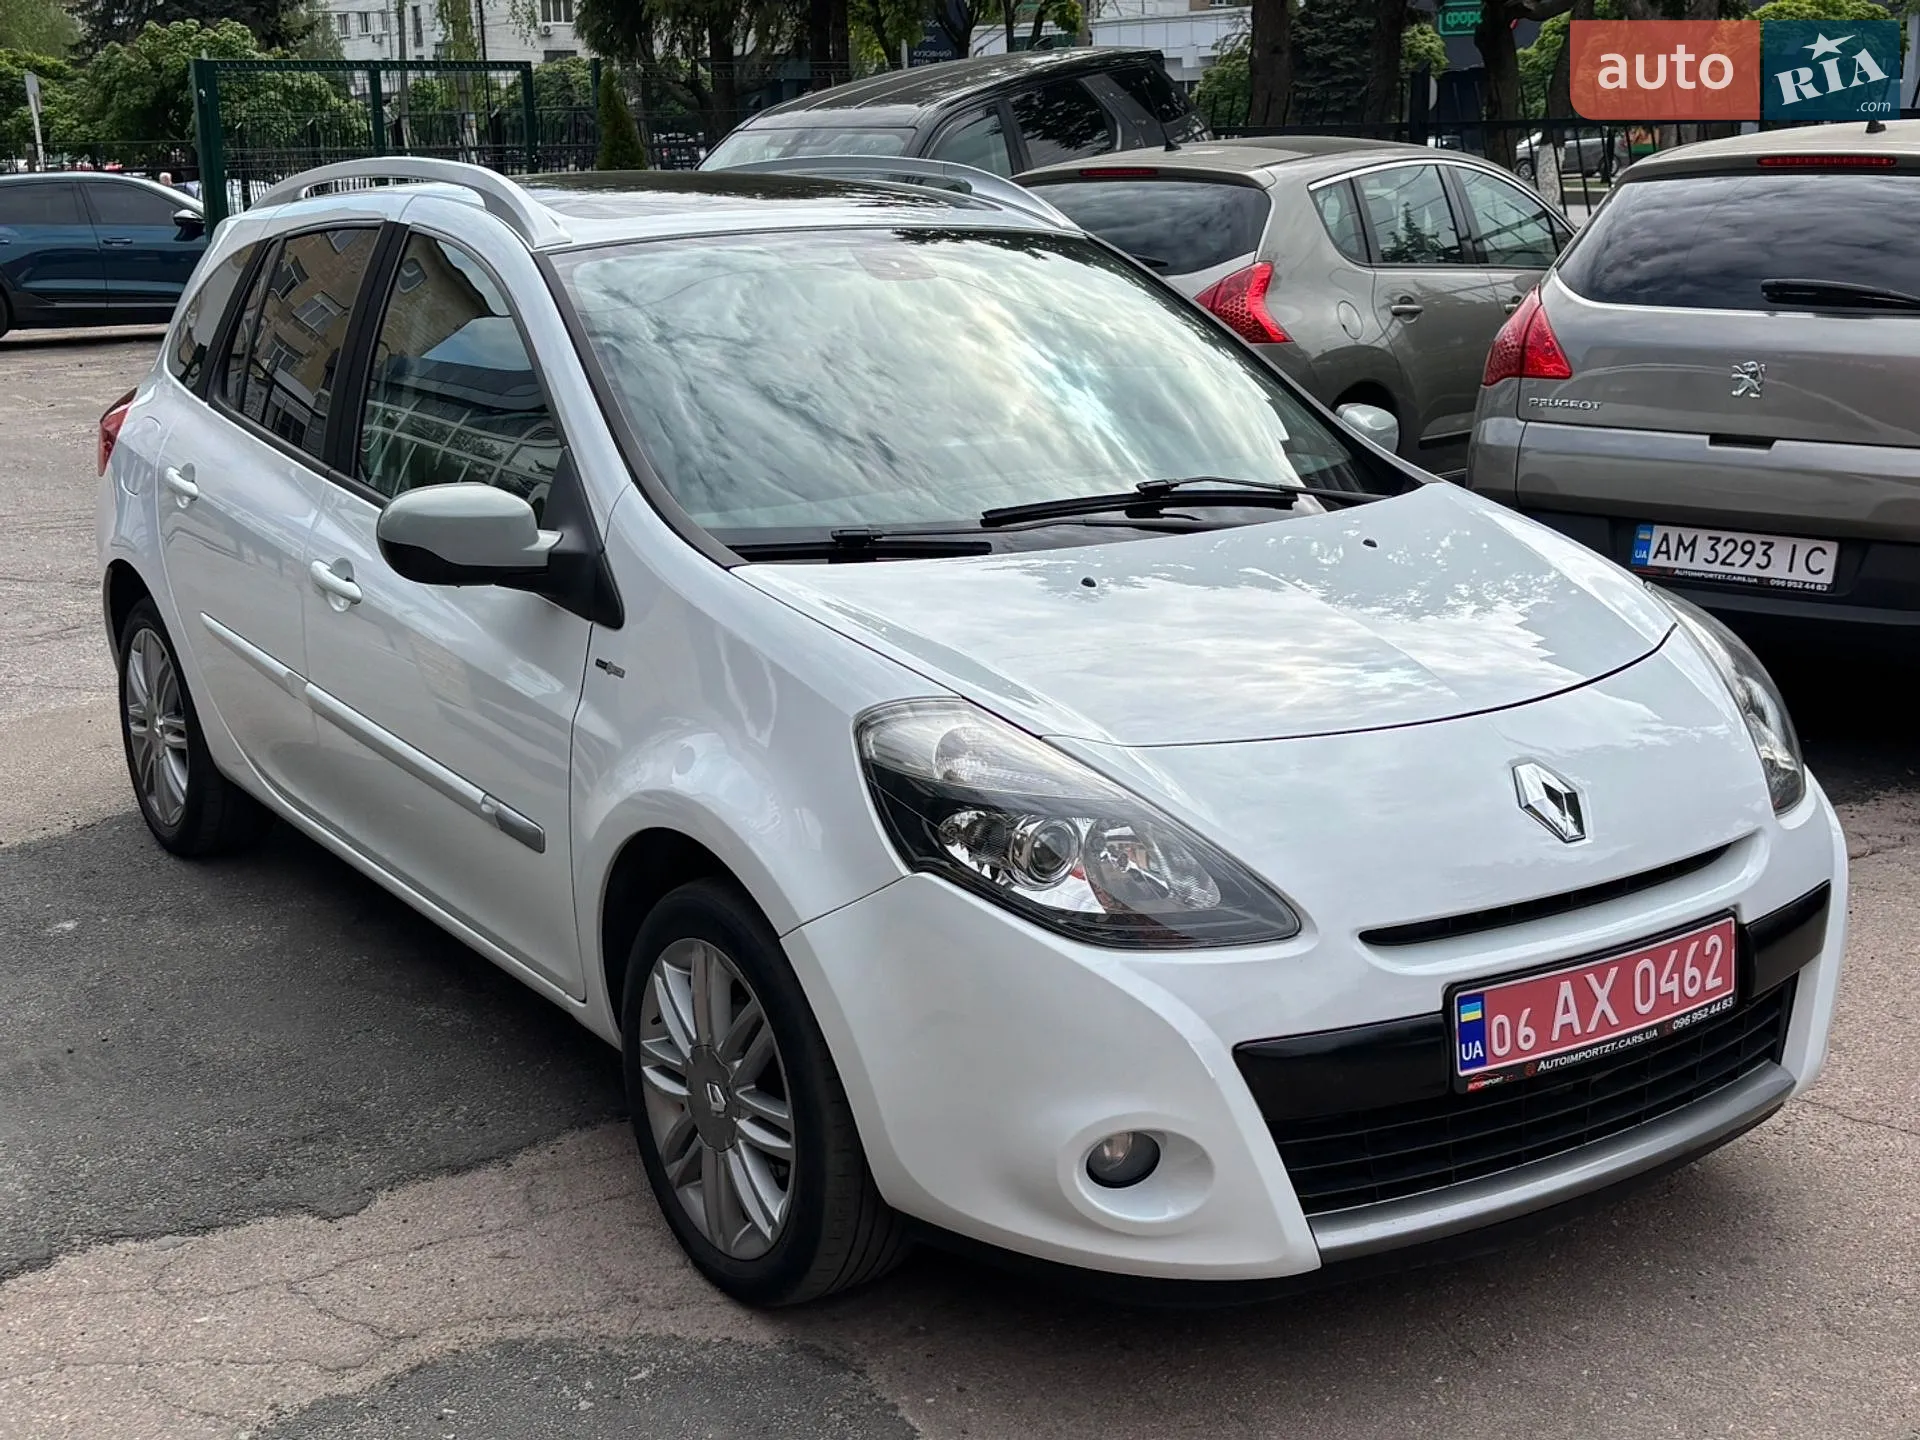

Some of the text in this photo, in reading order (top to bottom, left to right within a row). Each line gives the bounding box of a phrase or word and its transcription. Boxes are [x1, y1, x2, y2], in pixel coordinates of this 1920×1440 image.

[1528, 397, 1602, 410] PEUGEOT
[1635, 549, 1648, 559] UA
[1653, 532, 1828, 575] AM 3293 IC
[1490, 934, 1723, 1057] 06 AX 0462
[1461, 1040, 1484, 1061] UA
[1537, 1027, 1658, 1072] AUTOIMPORTZT.CARS.UA
